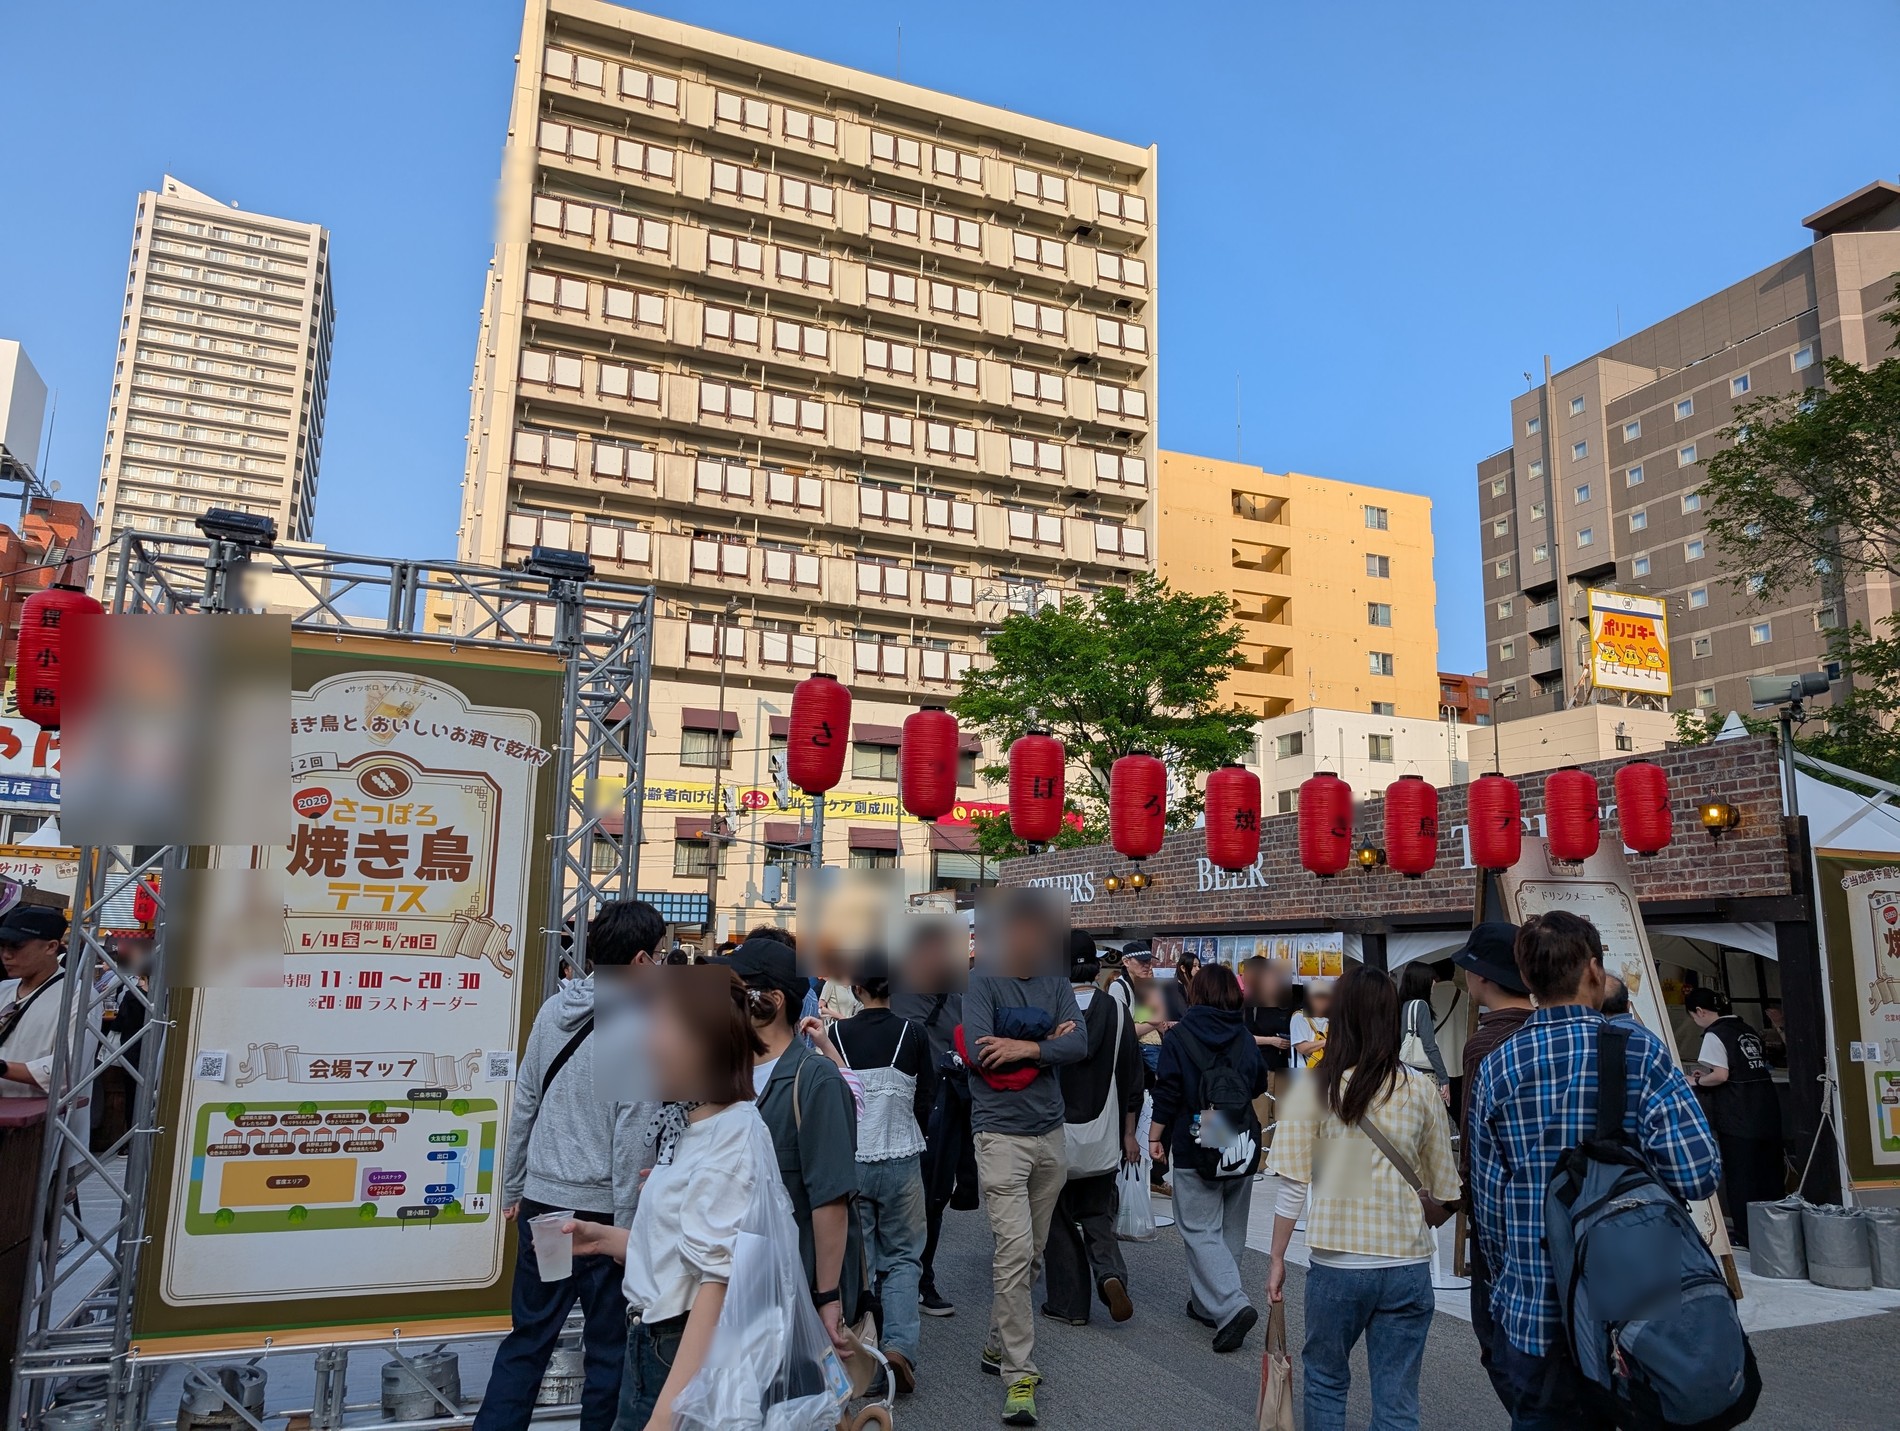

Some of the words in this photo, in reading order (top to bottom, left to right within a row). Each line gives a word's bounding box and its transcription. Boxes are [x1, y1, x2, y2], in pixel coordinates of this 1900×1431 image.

[1604, 618, 1655, 640] ポリンキー
[349, 684, 379, 693] サッポロ
[811, 721, 835, 747] さ
[291, 756, 324, 771] 2回
[1033, 775, 1059, 799] ぽ
[298, 795, 328, 808] 2026
[332, 797, 438, 826] さっぽろ
[1234, 807, 1257, 831] 焼
[286, 823, 474, 882] 焼き鳥
[327, 882, 430, 913] テラス
[1541, 891, 1604, 901] ドリンクメニュー
[350, 920, 398, 931] 開催期間
[368, 996, 478, 1011] ラストオーダー
[308, 1058, 418, 1079] 会場マップ
